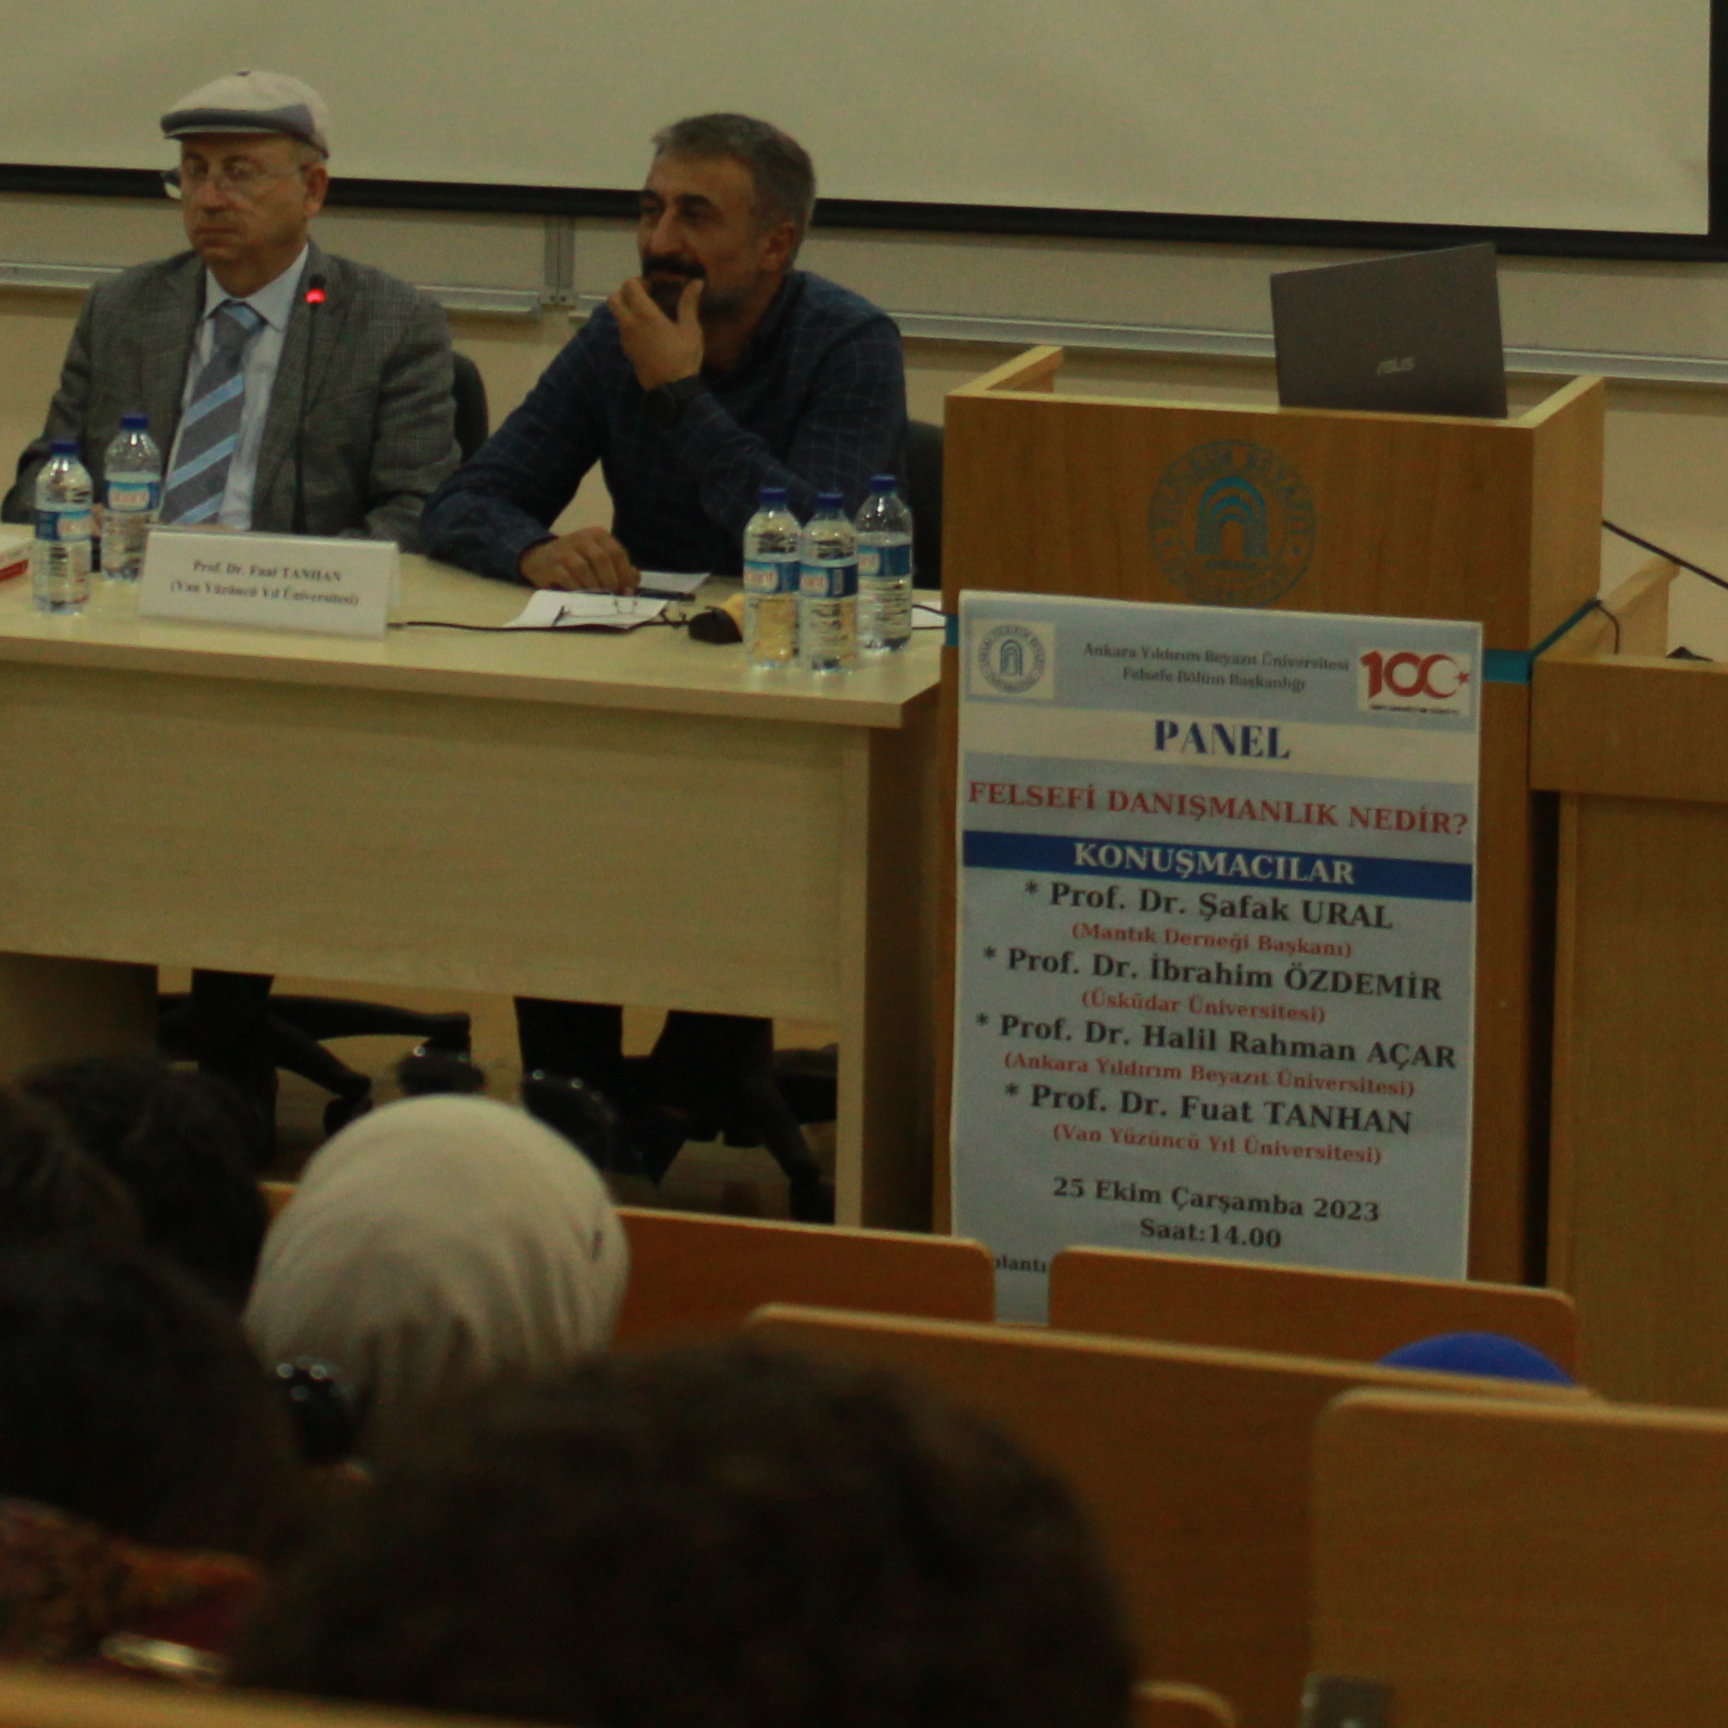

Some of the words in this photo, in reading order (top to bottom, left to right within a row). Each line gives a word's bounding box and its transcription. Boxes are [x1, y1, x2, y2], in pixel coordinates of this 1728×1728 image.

[1083, 642, 1136, 659] Ankara
[1262, 651, 1349, 671] Üniversitesi
[1123, 667, 1172, 683] Felsefe
[1154, 719, 1290, 759] PANEL
[968, 780, 1096, 811] FELSEFİ
[1107, 789, 1338, 827] DANIŞMANLIK
[1349, 805, 1468, 835] NEDİR?
[1073, 842, 1355, 885] KONUŞMACILAR
[1050, 881, 1125, 911] Prof.
[1139, 888, 1185, 915] Dr.
[1199, 892, 1289, 922] Şafak
[1302, 899, 1392, 929] URAL
[1072, 922, 1156, 943] (Mantık
[1165, 928, 1249, 953] Derneği
[1258, 934, 1353, 958] Başkanı)
[1008, 947, 1079, 974] Prof.
[1093, 953, 1138, 979] Dr.
[1150, 952, 1272, 988] İbrahim
[1284, 962, 1442, 1000] ÖZDEMİR
[1081, 987, 1181, 1013] (Üsküdar
[1189, 994, 1326, 1023] Üniversitesi)
[1000, 1014, 1071, 1041] Prof.
[1085, 1020, 1129, 1046] Dr.
[1142, 1024, 1217, 1051] Halil
[1229, 1030, 1356, 1062] Rahman
[1367, 1041, 1456, 1070] AÇAR
[1005, 1051, 1089, 1073] (Ankara
[1096, 1057, 1182, 1079] Yıldırım
[1191, 1064, 1268, 1087] Beyazıt
[1277, 1068, 1414, 1098] Üniversitesi)
[1030, 1083, 1106, 1112] Prof.
[1120, 1089, 1167, 1117] Dr.
[1180, 1095, 1252, 1123] Fuat
[1264, 1101, 1412, 1135] TANHAN
[1053, 1124, 1102, 1143] (Van
[1110, 1127, 1200, 1151] Yüzüncü
[1208, 1135, 1235, 1154] Yıl
[1243, 1135, 1382, 1165] Üniversitesi)
[1053, 1176, 1085, 1198] 25
[1095, 1179, 1162, 1205] Ekim
[1172, 1185, 1304, 1216] Çarşamba
[1313, 1197, 1379, 1222] 2023
[1140, 1218, 1281, 1248] Saat:14.00
